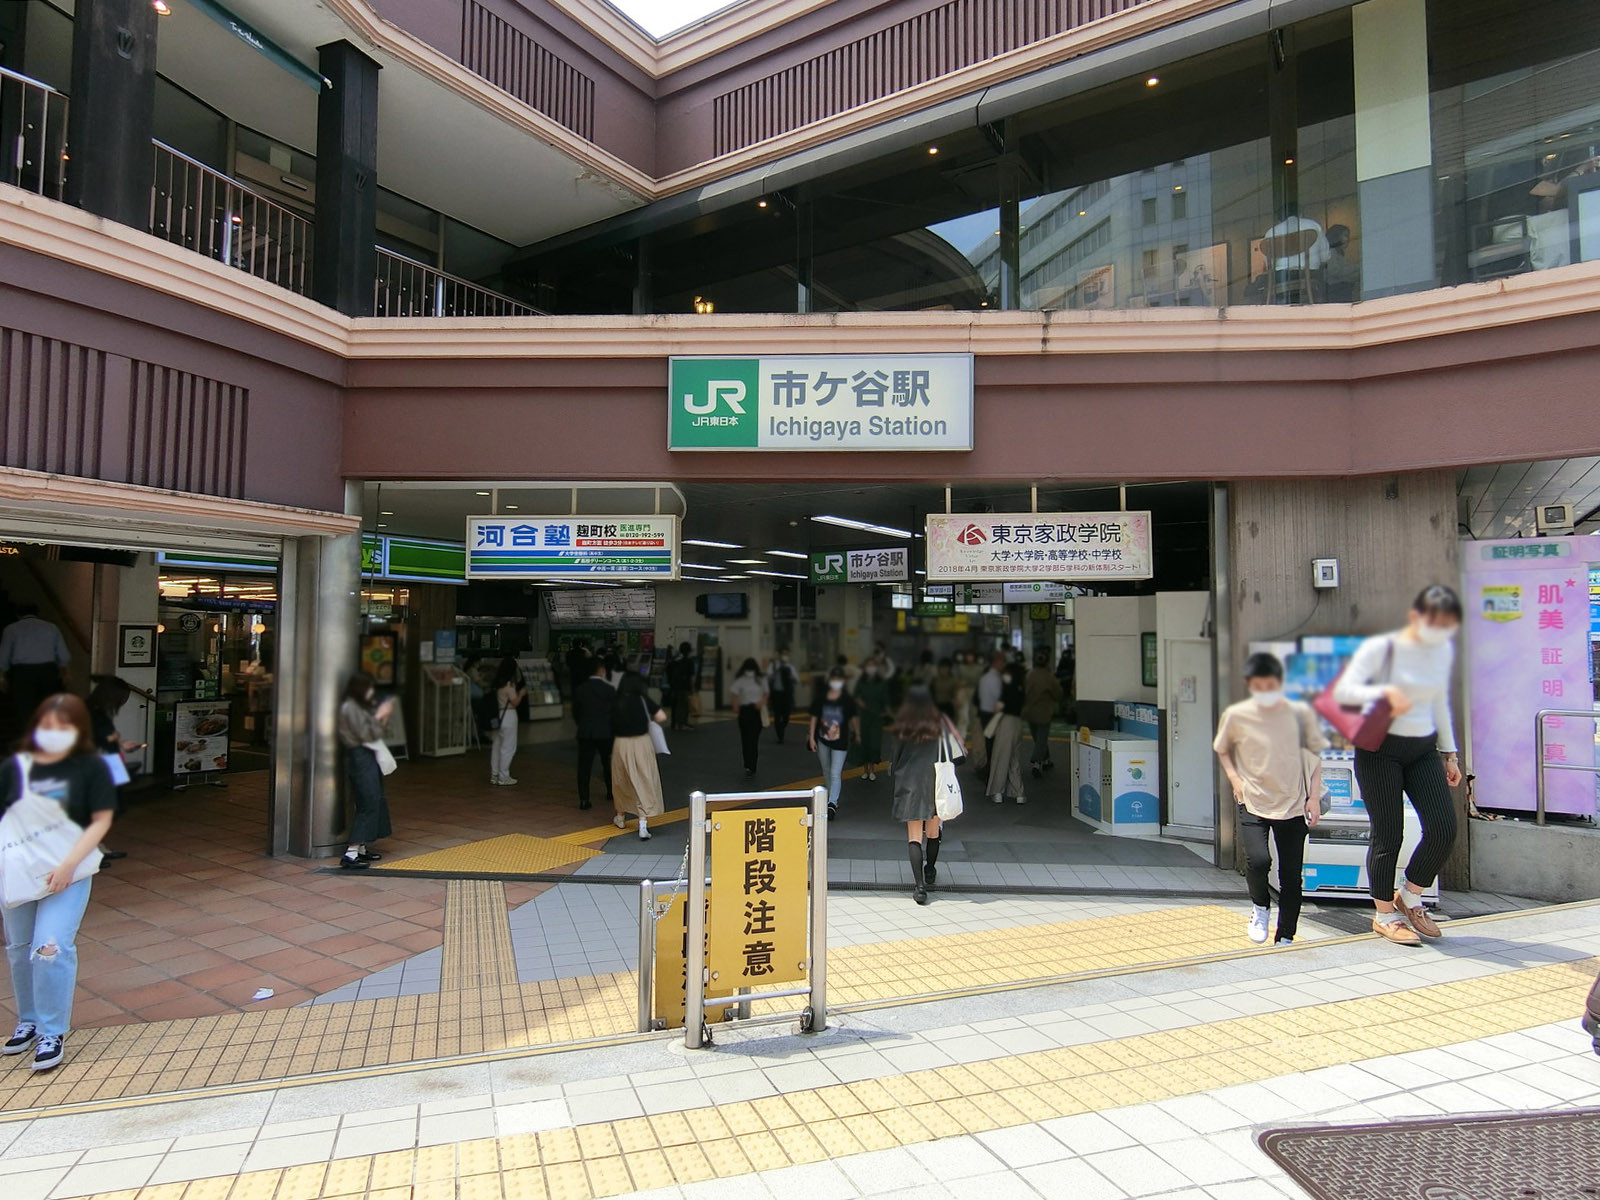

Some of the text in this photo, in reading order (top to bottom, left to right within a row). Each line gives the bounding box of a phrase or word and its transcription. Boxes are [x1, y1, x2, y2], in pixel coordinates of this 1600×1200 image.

[683, 380, 747, 415] JR
[769, 369, 931, 408] 市ケ谷駅
[692, 416, 739, 427] JR東日本
[769, 415, 947, 441] Ichigaya Station
[477, 524, 571, 548] 河合塾
[576, 524, 617, 538] 麹町校
[991, 523, 1122, 544] 東京家政学院
[850, 551, 904, 568] 市ケ谷駅
[1492, 544, 1559, 559] 証明写真
[814, 554, 844, 574] JR
[938, 565, 978, 573] 2018年4月
[850, 569, 904, 580] Ichigaya Station
[742, 818, 777, 977] 階段注意
